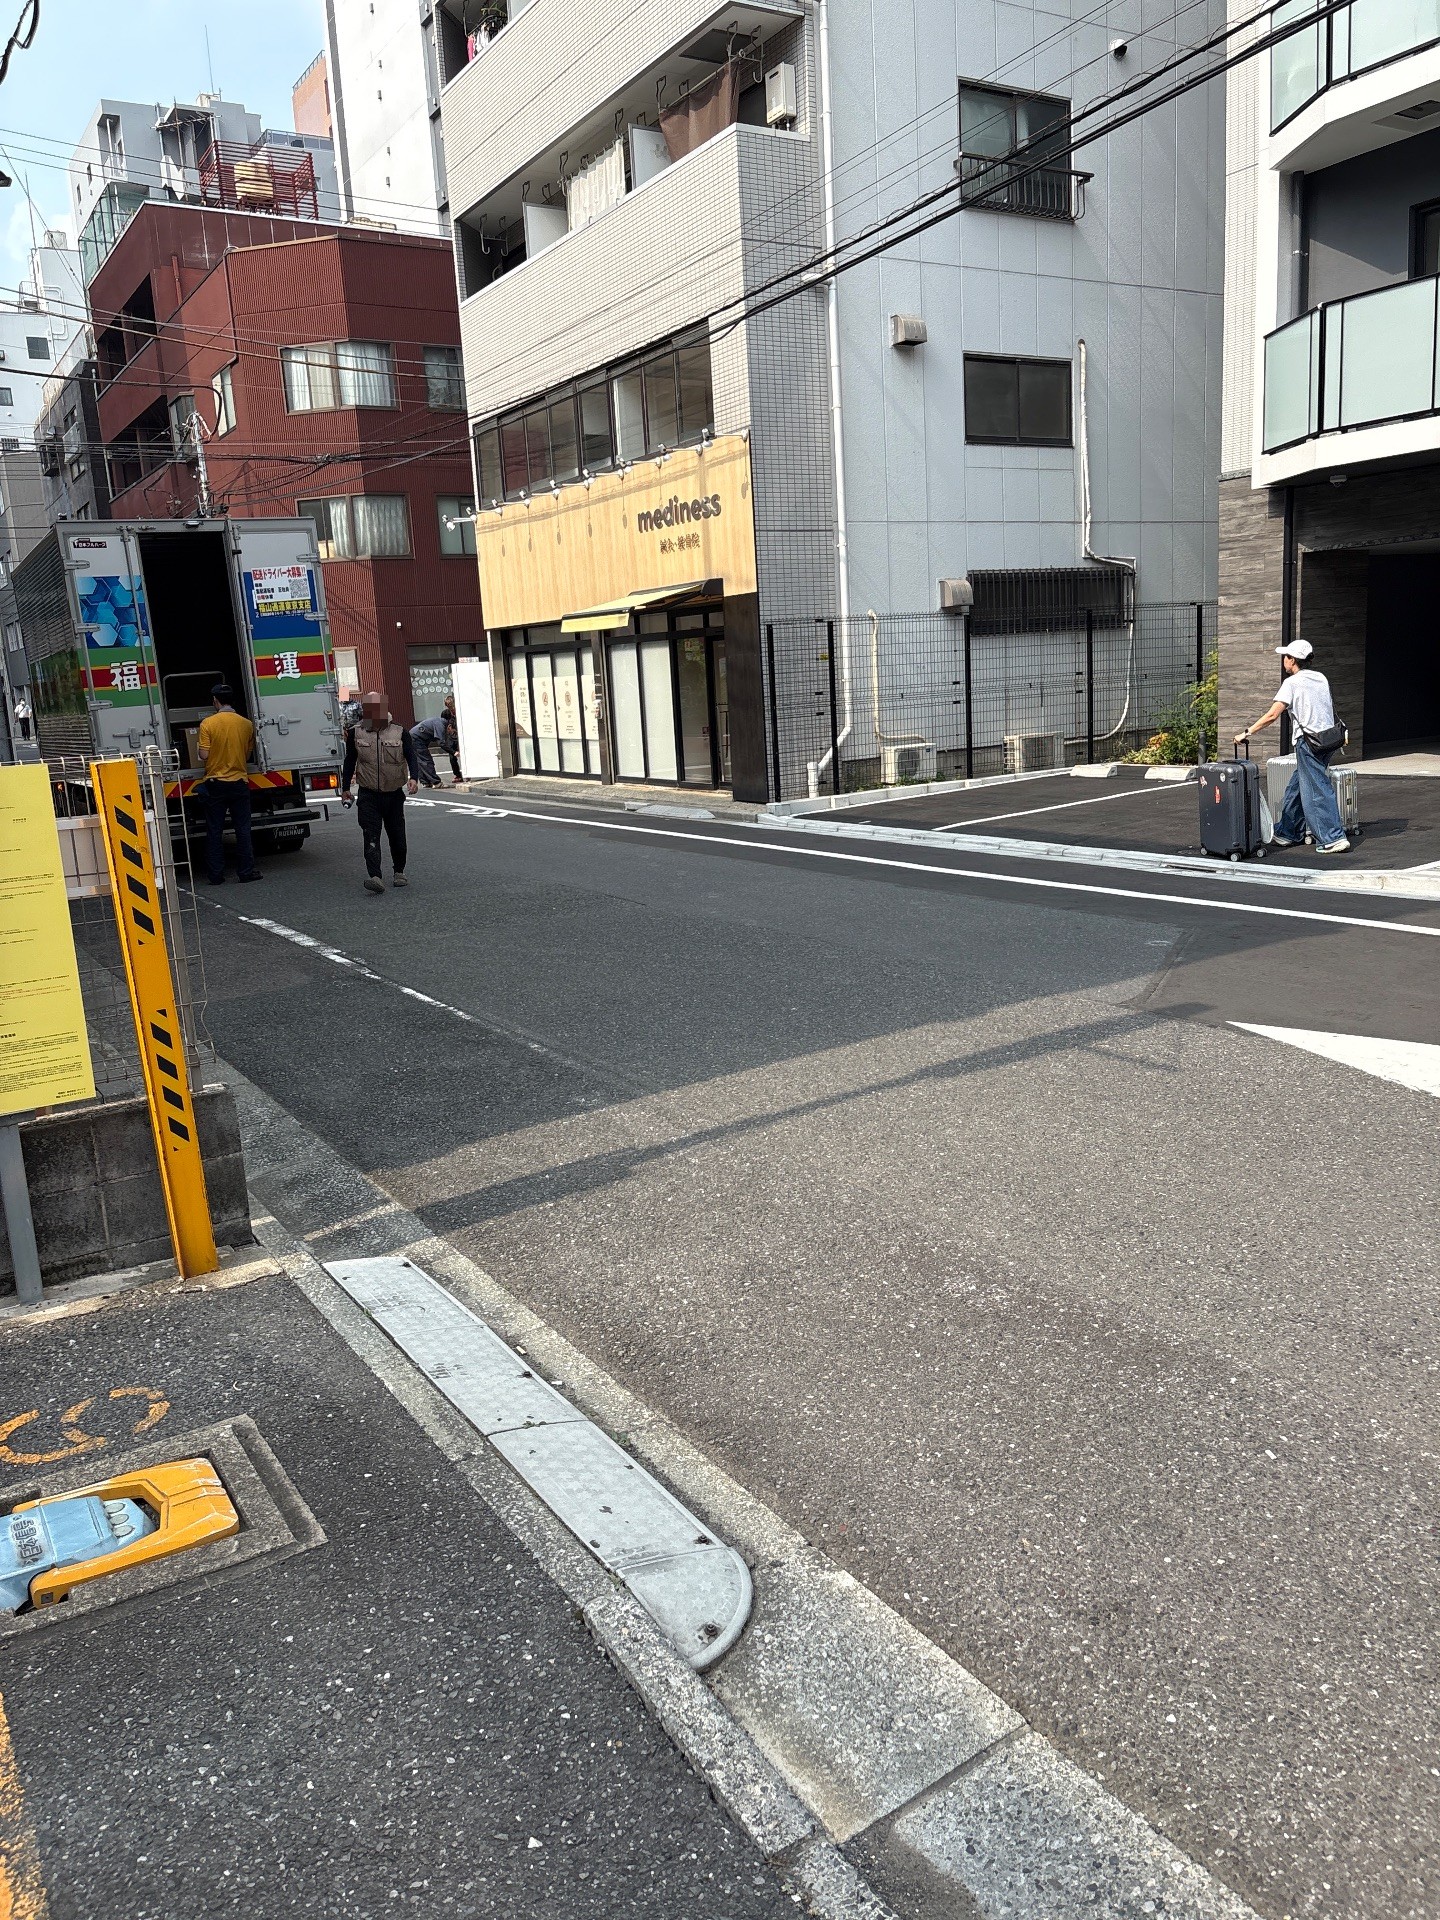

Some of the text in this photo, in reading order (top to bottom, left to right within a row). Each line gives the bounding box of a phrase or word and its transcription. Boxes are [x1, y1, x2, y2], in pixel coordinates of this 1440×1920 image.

[637, 493, 722, 533] mediness
[110, 660, 142, 692] 福
[273, 651, 302, 681] 運
